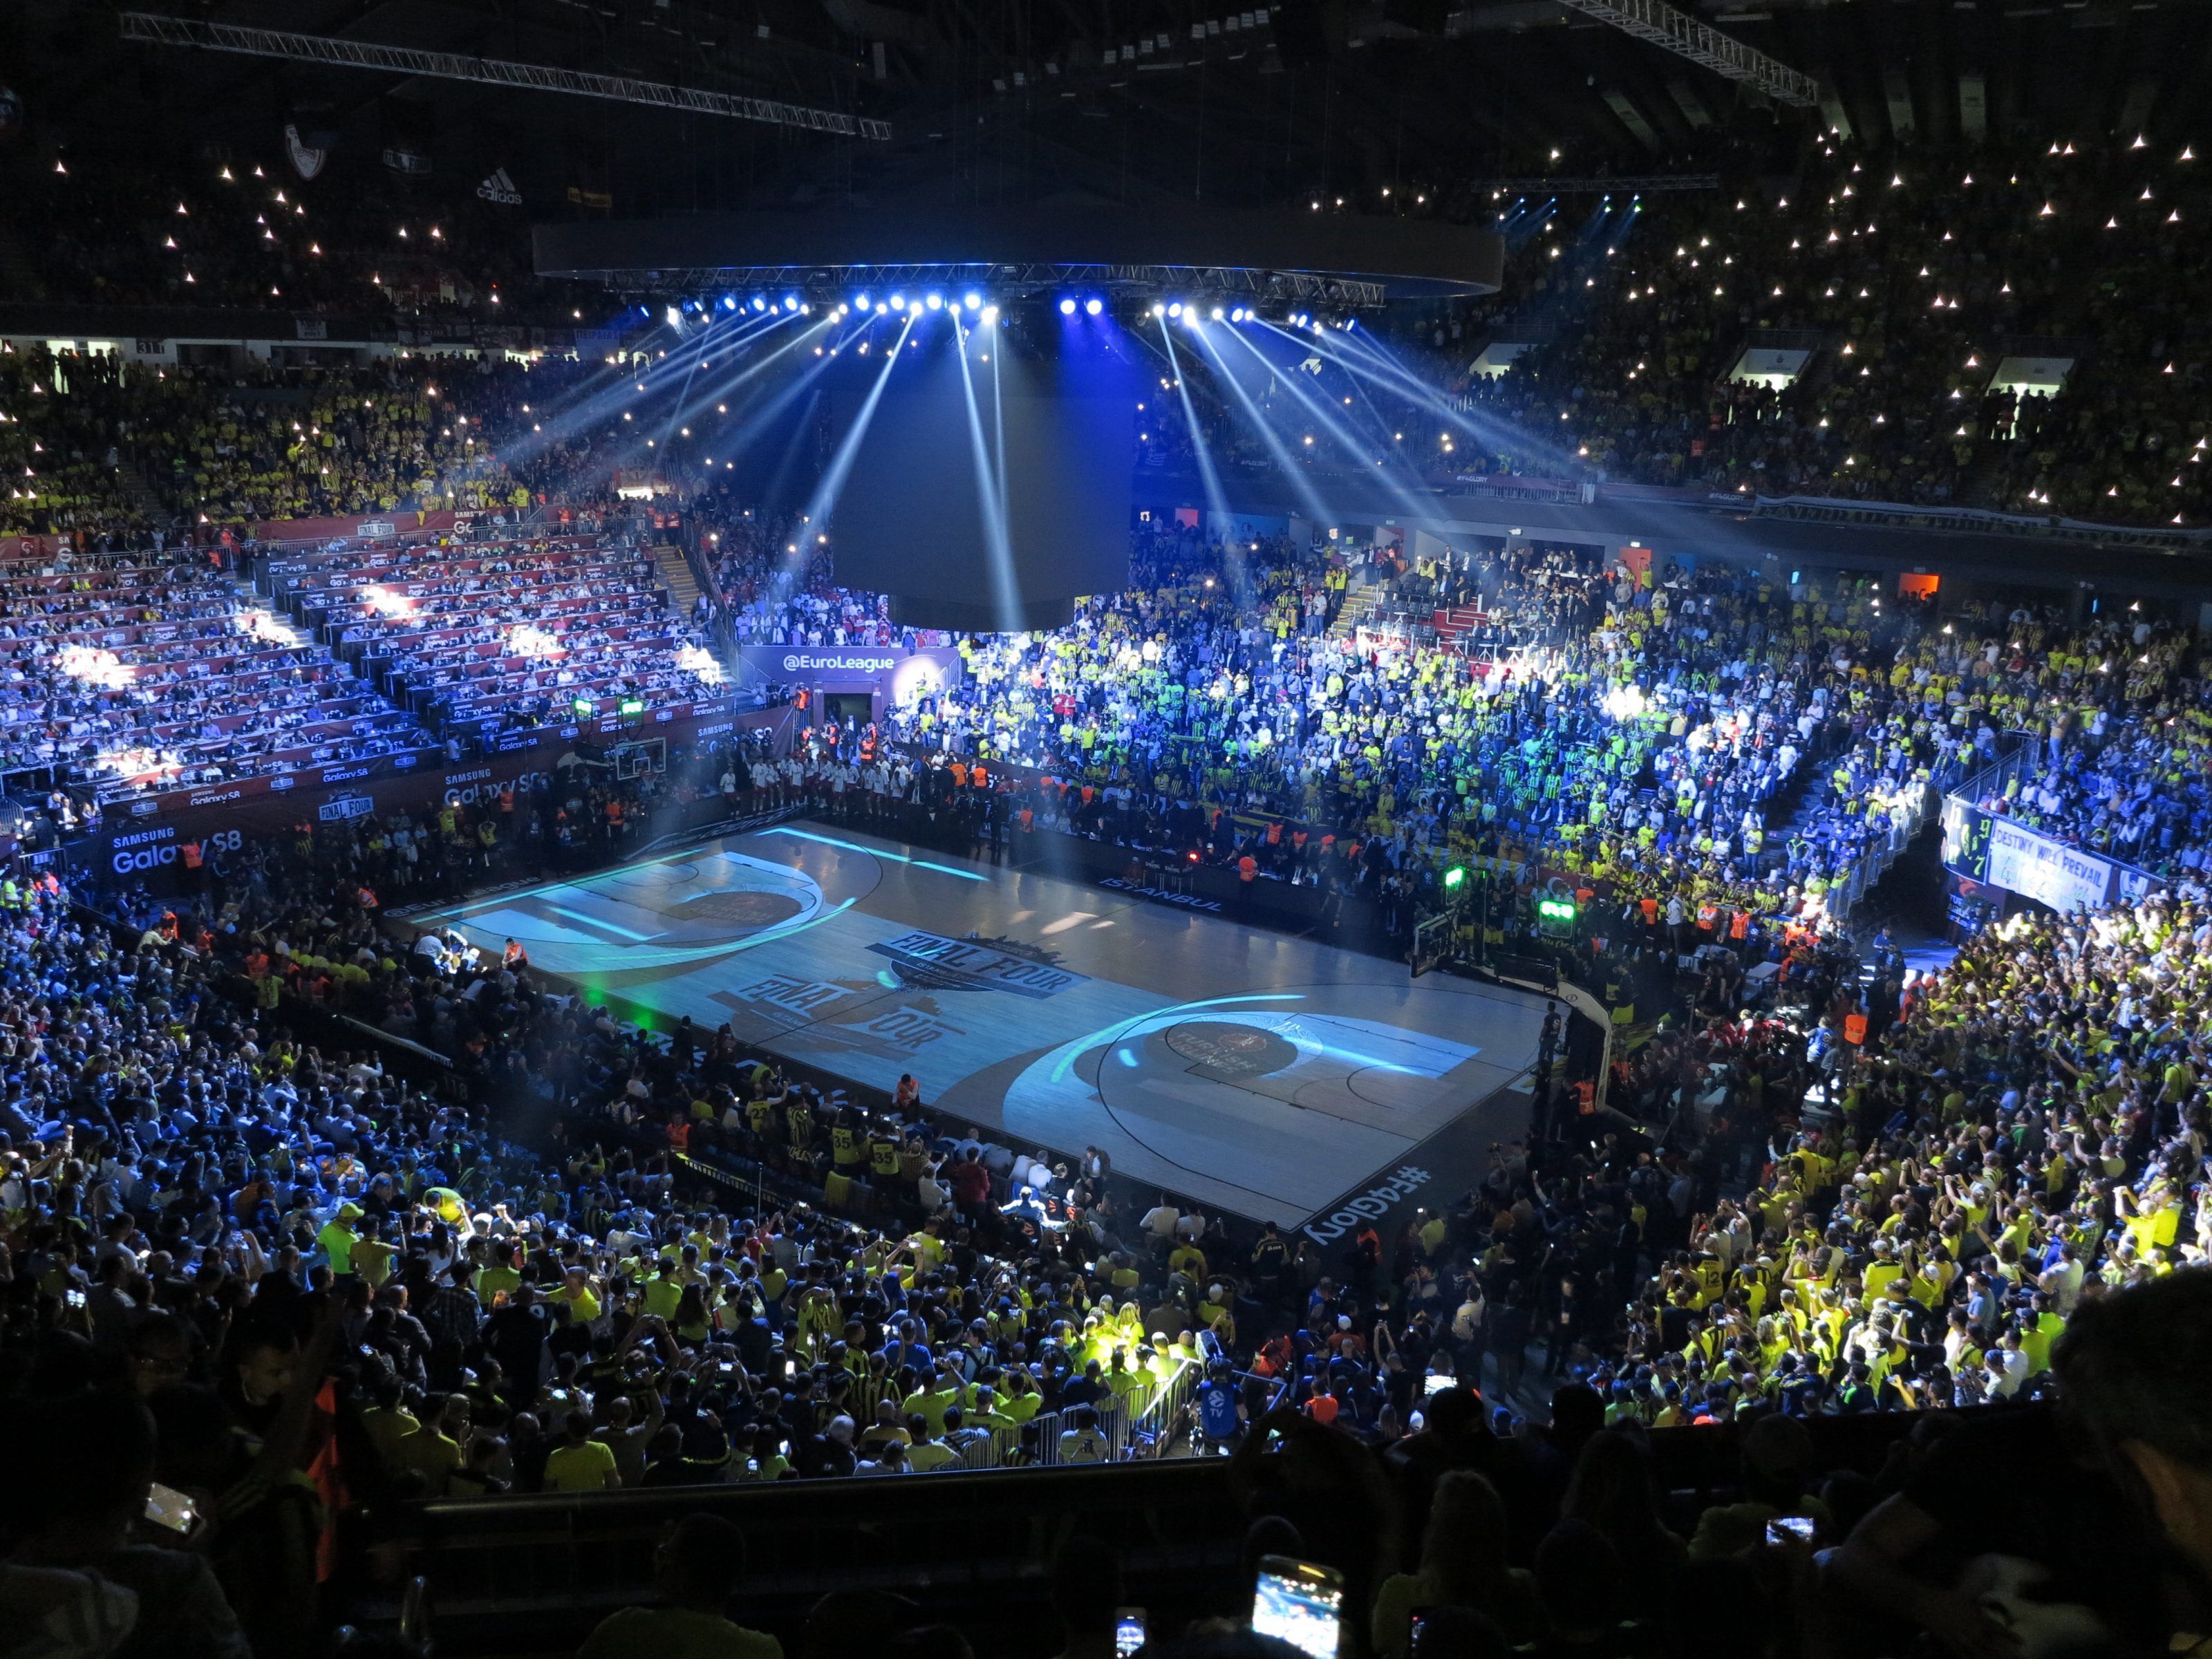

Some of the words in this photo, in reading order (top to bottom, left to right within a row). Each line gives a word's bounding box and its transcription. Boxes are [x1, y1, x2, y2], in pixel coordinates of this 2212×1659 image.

[476, 187, 523, 205] adidas
[783, 655, 894, 673] @EuroLeague
[697, 722, 733, 737] SAMSUNG
[323, 771, 357, 783] Galaxy
[356, 768, 368, 777] S8
[445, 768, 491, 785] SAMSUNG
[190, 794, 228, 807] Galaxy
[228, 790, 241, 800] S8
[321, 803, 345, 821] FINAL
[349, 798, 371, 814] FOUR
[113, 827, 175, 849] SAMSUNG
[113, 839, 207, 874] Gala
[212, 830, 243, 854] S8
[1997, 828, 2034, 854] DESTINY
[2036, 843, 2058, 865] WILL
[2063, 858, 2103, 888] PREVAIL
[891, 933, 982, 968] FINAL
[973, 957, 1073, 991] FOUR
[868, 1012, 946, 1049] OUR
[834, 1136, 850, 1149] 35
[874, 1152, 893, 1164] 35
[1303, 1165, 1432, 1246] #F4Glory
[1210, 1408, 1224, 1418] TV
